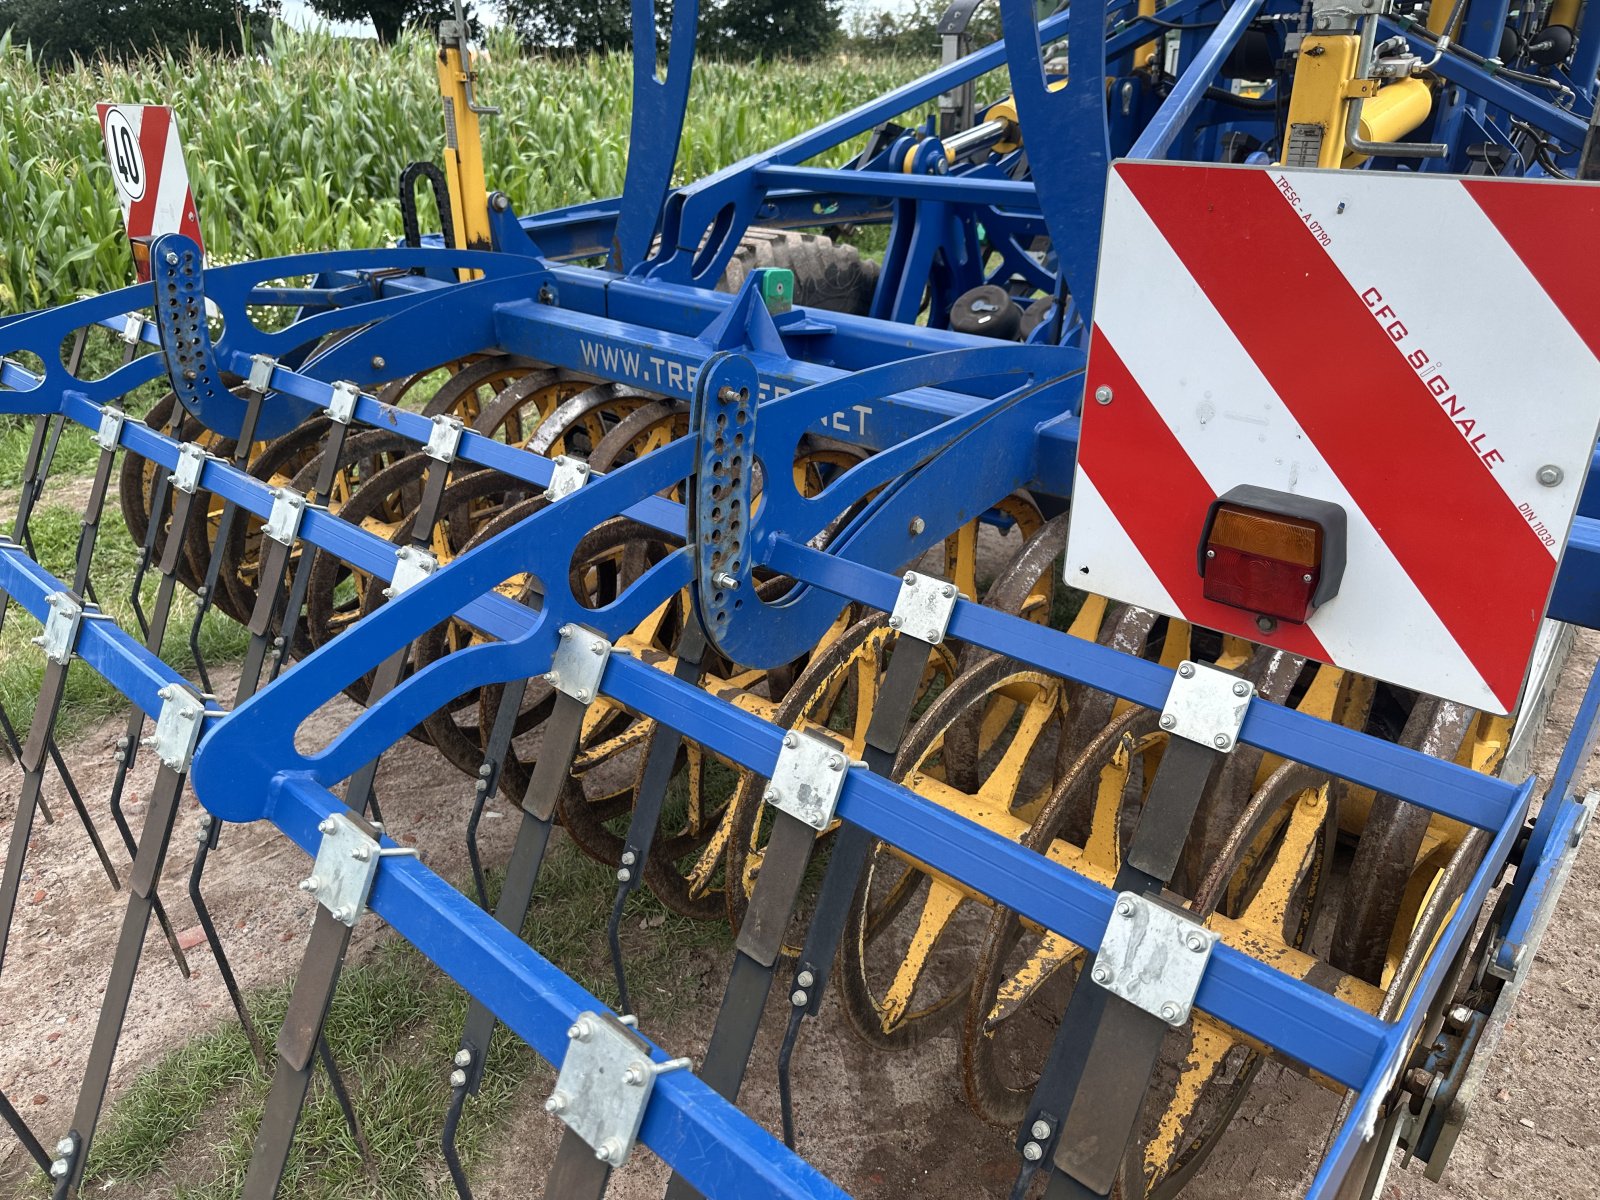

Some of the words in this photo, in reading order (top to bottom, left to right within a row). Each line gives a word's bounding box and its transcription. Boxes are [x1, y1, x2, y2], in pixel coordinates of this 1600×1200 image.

[111, 124, 140, 185] 40
[1276, 175, 1301, 207] TPESC
[1302, 213, 1313, 223] A
[1309, 221, 1332, 247] 07190
[1361, 287, 1409, 342] CFG
[1518, 502, 1538, 522] DIN
[1532, 521, 1556, 547] 11030
